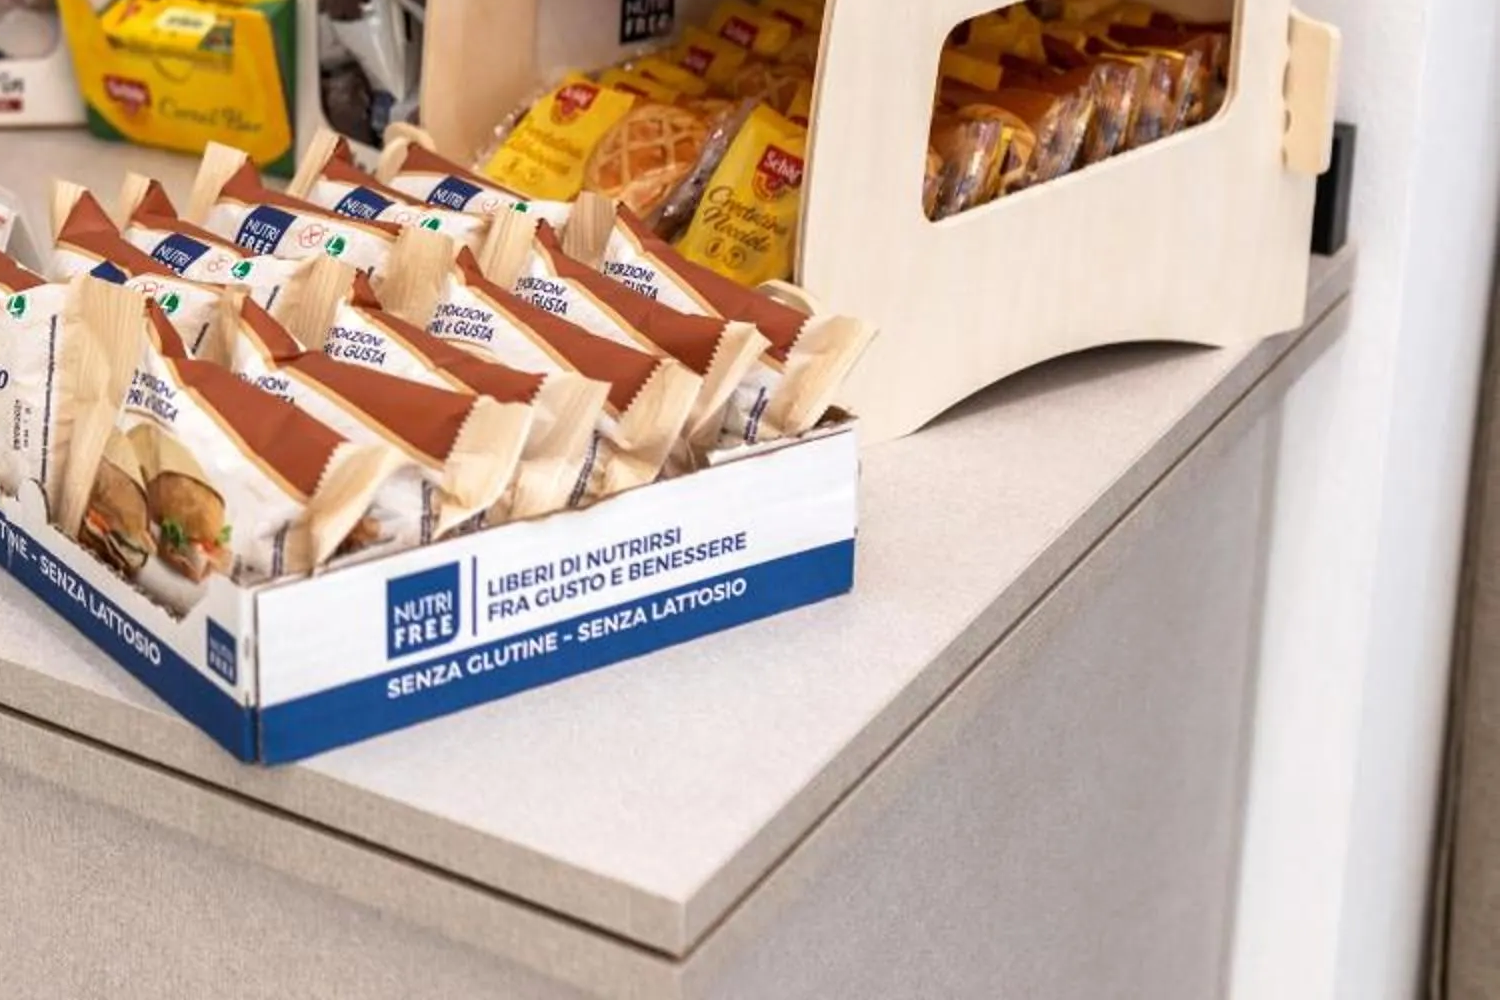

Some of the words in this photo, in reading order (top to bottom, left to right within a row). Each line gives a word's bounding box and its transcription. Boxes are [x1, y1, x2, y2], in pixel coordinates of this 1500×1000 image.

[342, 196, 376, 219] NUTRI
[433, 188, 466, 210] NUTRI
[244, 218, 282, 243] NUTRI
[156, 244, 193, 266] NUTRI
[237, 232, 274, 256] FREE
[453, 320, 495, 342] GUSTA
[343, 345, 387, 367] GUSTA
[487, 562, 555, 597] LIBERI
[559, 554, 581, 578] DI
[586, 526, 683, 570] NUTRIRSI
[487, 598, 531, 623] FRA
[535, 572, 607, 609] GUSTO
[610, 566, 624, 587] E
[628, 530, 748, 583] BENESSERE
[39, 555, 88, 610] SENZA
[88, 592, 163, 667] LATTOSIO
[393, 588, 454, 627] NUTRI
[386, 659, 464, 700] SENZA
[466, 630, 559, 676] GLUTINE
[576, 607, 648, 643] SENZA
[650, 576, 748, 621] LATTOSIO
[394, 613, 454, 650] FREE
